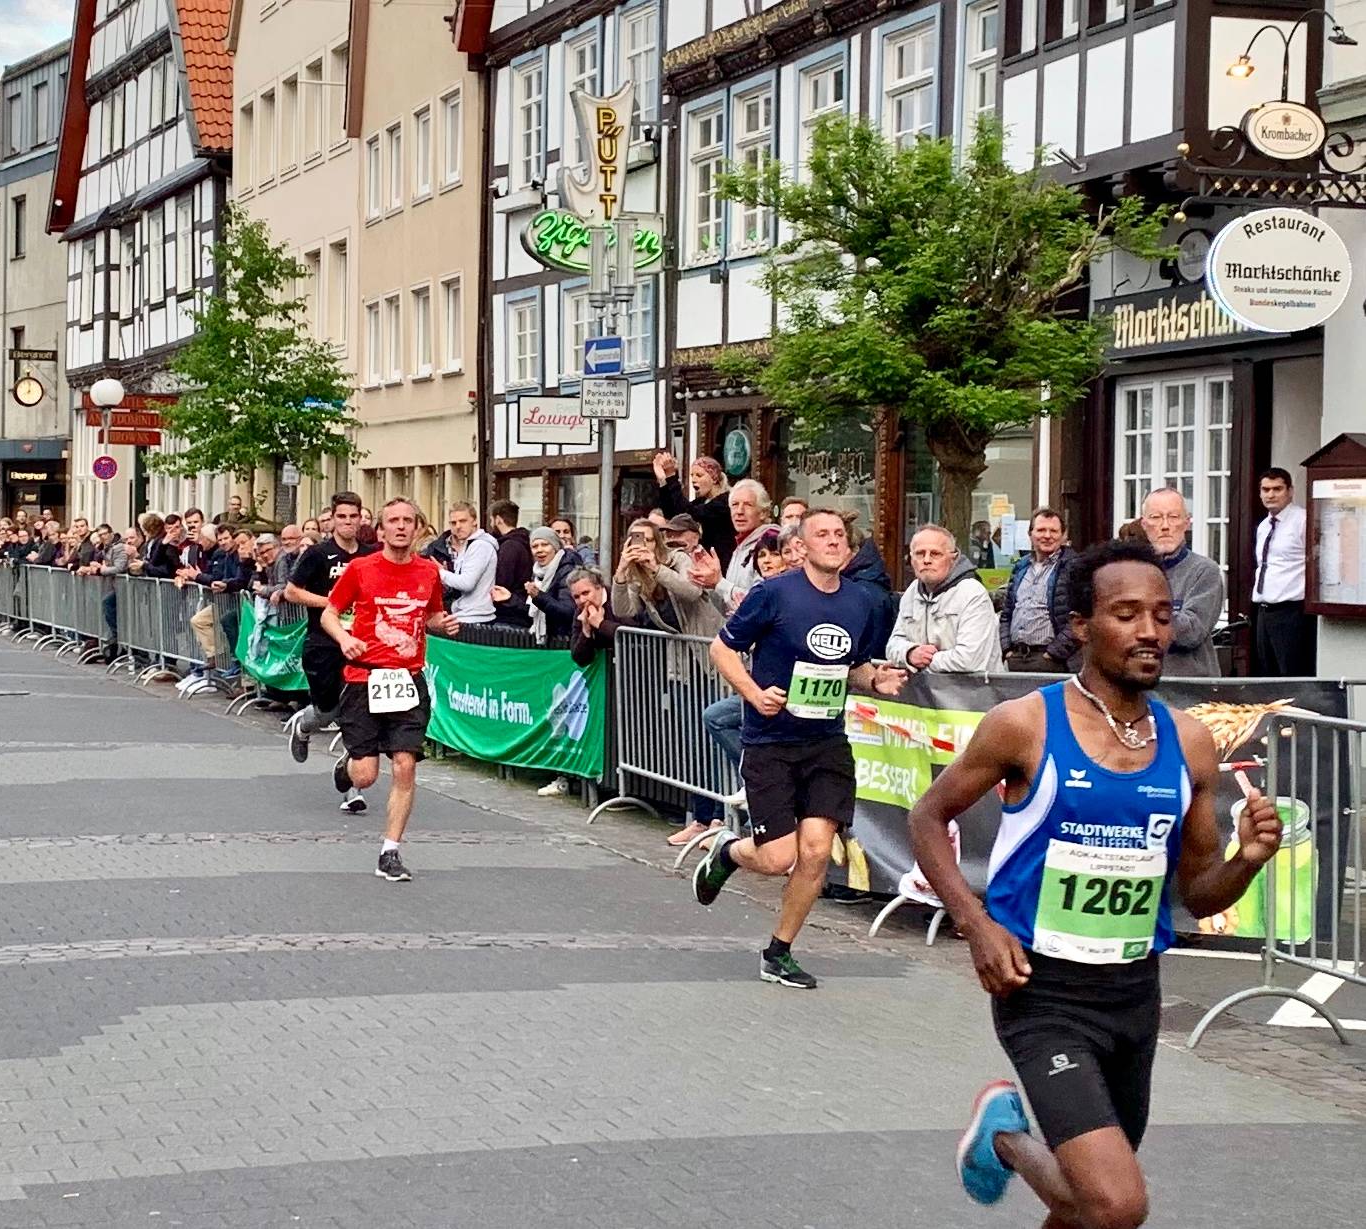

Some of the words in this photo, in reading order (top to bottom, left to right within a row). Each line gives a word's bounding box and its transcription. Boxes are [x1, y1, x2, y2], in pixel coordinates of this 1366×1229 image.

[1260, 125, 1313, 143] Krombacher
[596, 107, 624, 220] PÜTT
[1242, 215, 1326, 243] Restaurant
[1224, 262, 1342, 283] Marktschänke
[586, 389, 624, 398] Parkschein
[522, 406, 586, 431] Lounge
[810, 633, 852, 655] HELLA
[381, 671, 404, 681] AOK
[371, 683, 416, 700] 2125
[799, 677, 843, 698] 1170
[488, 688, 499, 720] in
[500, 691, 534, 726] Form.
[855, 757, 918, 804] BESSER!
[1060, 821, 1145, 839] STADTWERKE
[1059, 874, 1154, 916] 1262
